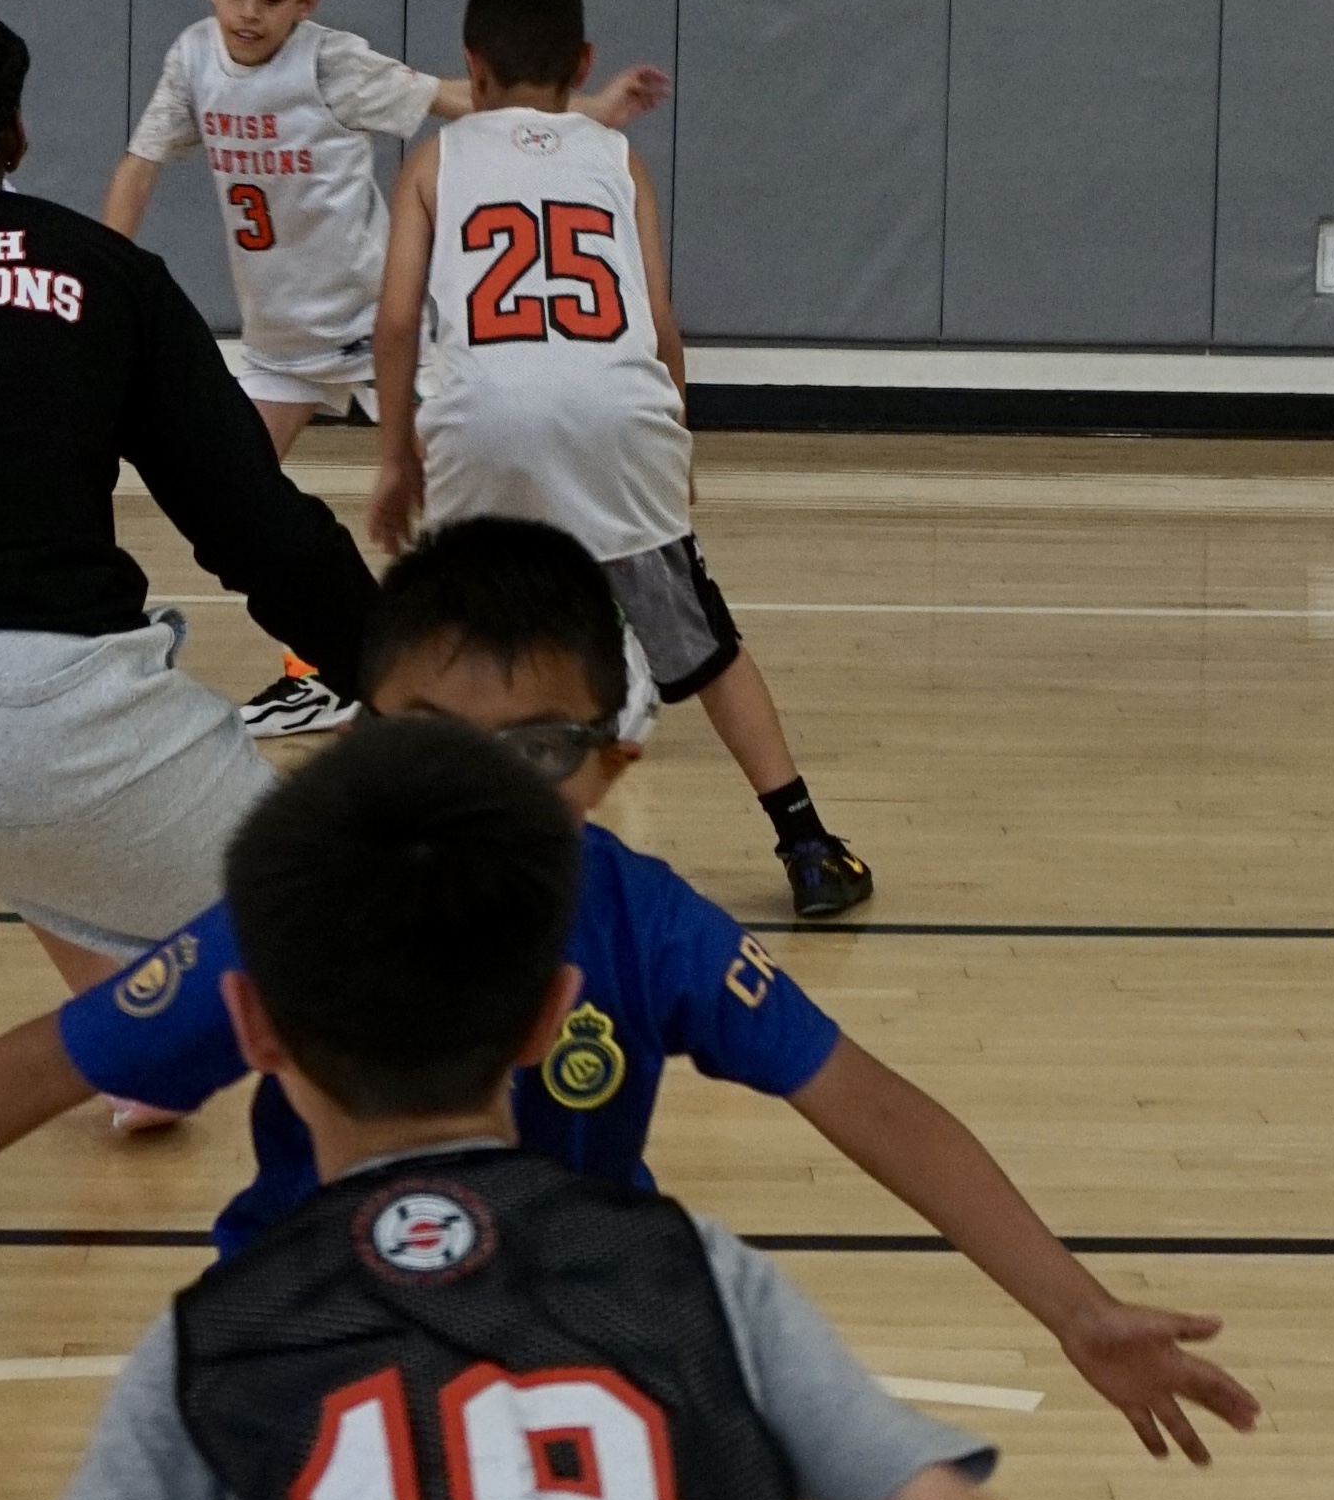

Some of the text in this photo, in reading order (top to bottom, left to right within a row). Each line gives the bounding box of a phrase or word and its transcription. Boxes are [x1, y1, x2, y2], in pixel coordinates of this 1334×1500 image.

[204, 111, 278, 140] SWISH
[209, 147, 314, 174] LUTIONS
[227, 182, 276, 252] 3
[460, 199, 629, 345] 25
